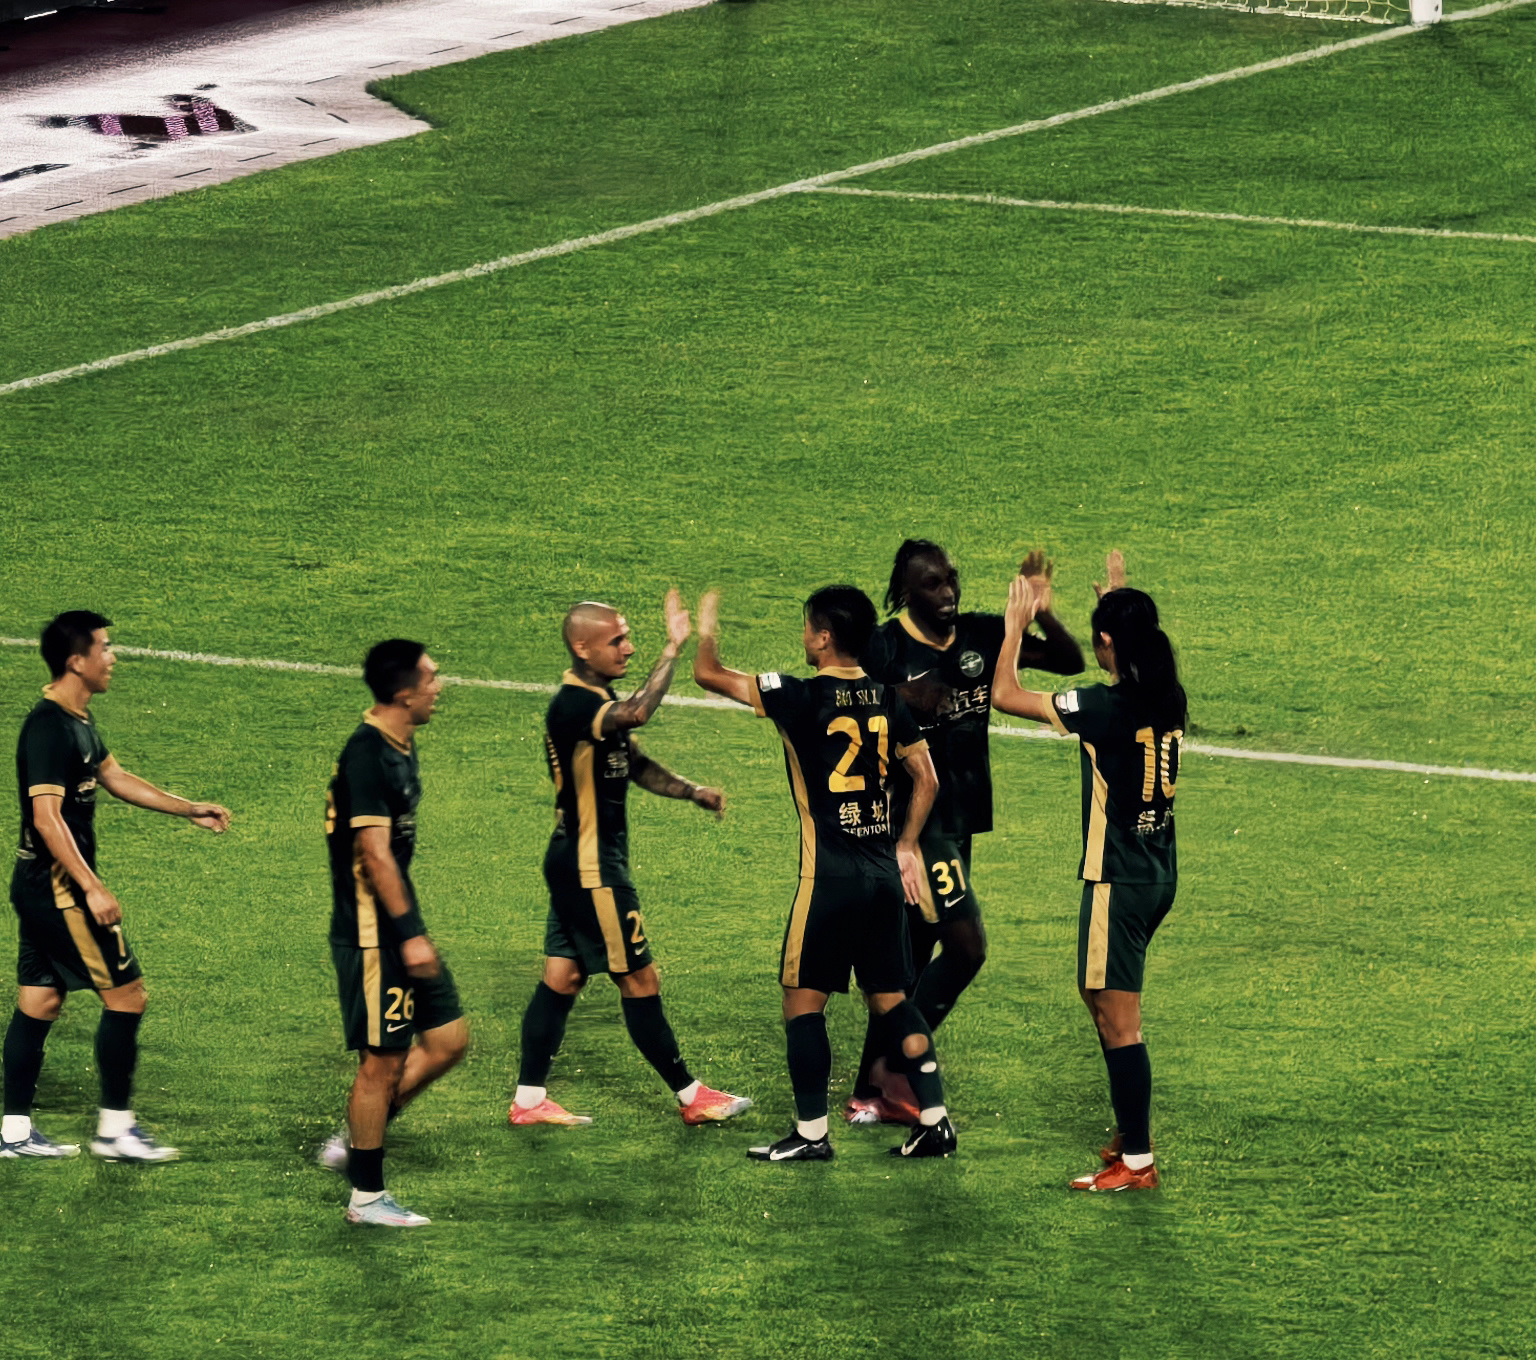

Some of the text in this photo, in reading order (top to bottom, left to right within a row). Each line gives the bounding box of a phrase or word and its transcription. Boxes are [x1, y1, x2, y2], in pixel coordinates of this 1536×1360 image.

[827, 715, 889, 793] 21
[1135, 726, 1184, 802] 10
[932, 859, 966, 895] 31
[384, 986, 414, 1021] 26
